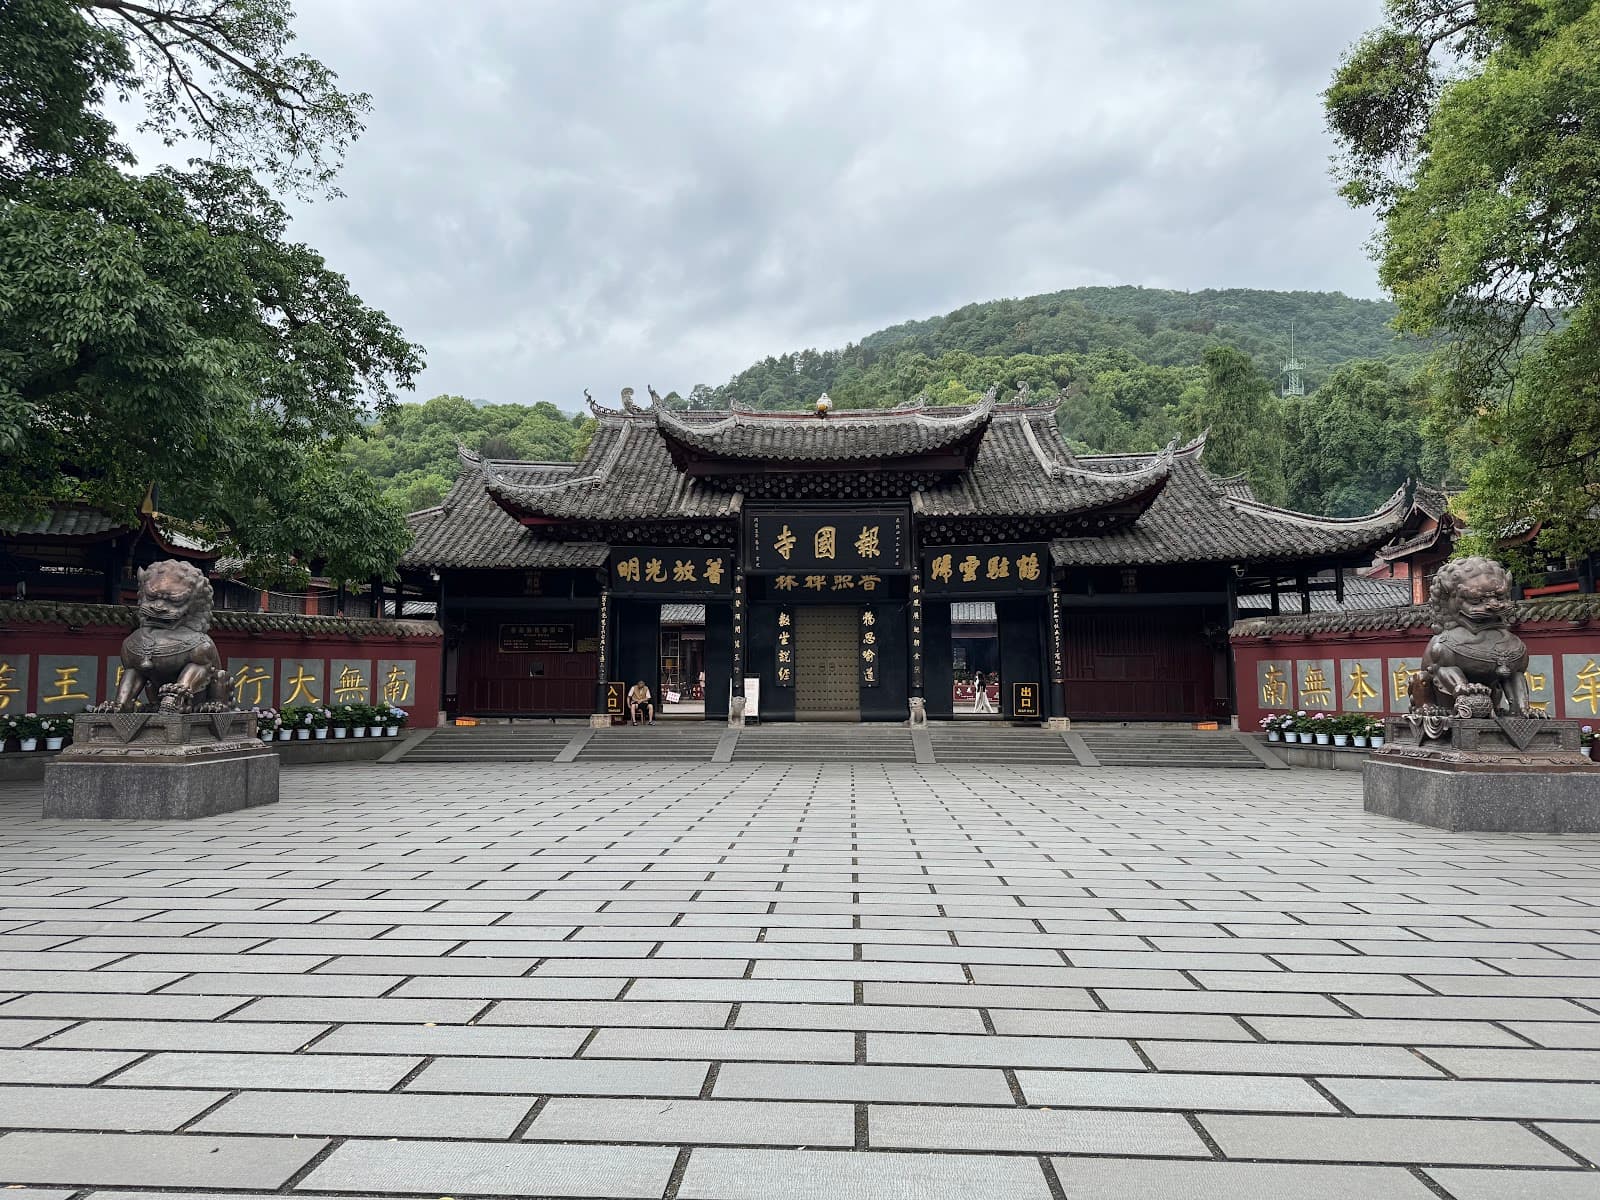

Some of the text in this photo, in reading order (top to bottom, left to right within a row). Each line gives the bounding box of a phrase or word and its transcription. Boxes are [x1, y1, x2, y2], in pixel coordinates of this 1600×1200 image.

[773, 524, 881, 561] 報國寺
[607, 685, 619, 708] 入口
[1020, 686, 1032, 708] 出口
